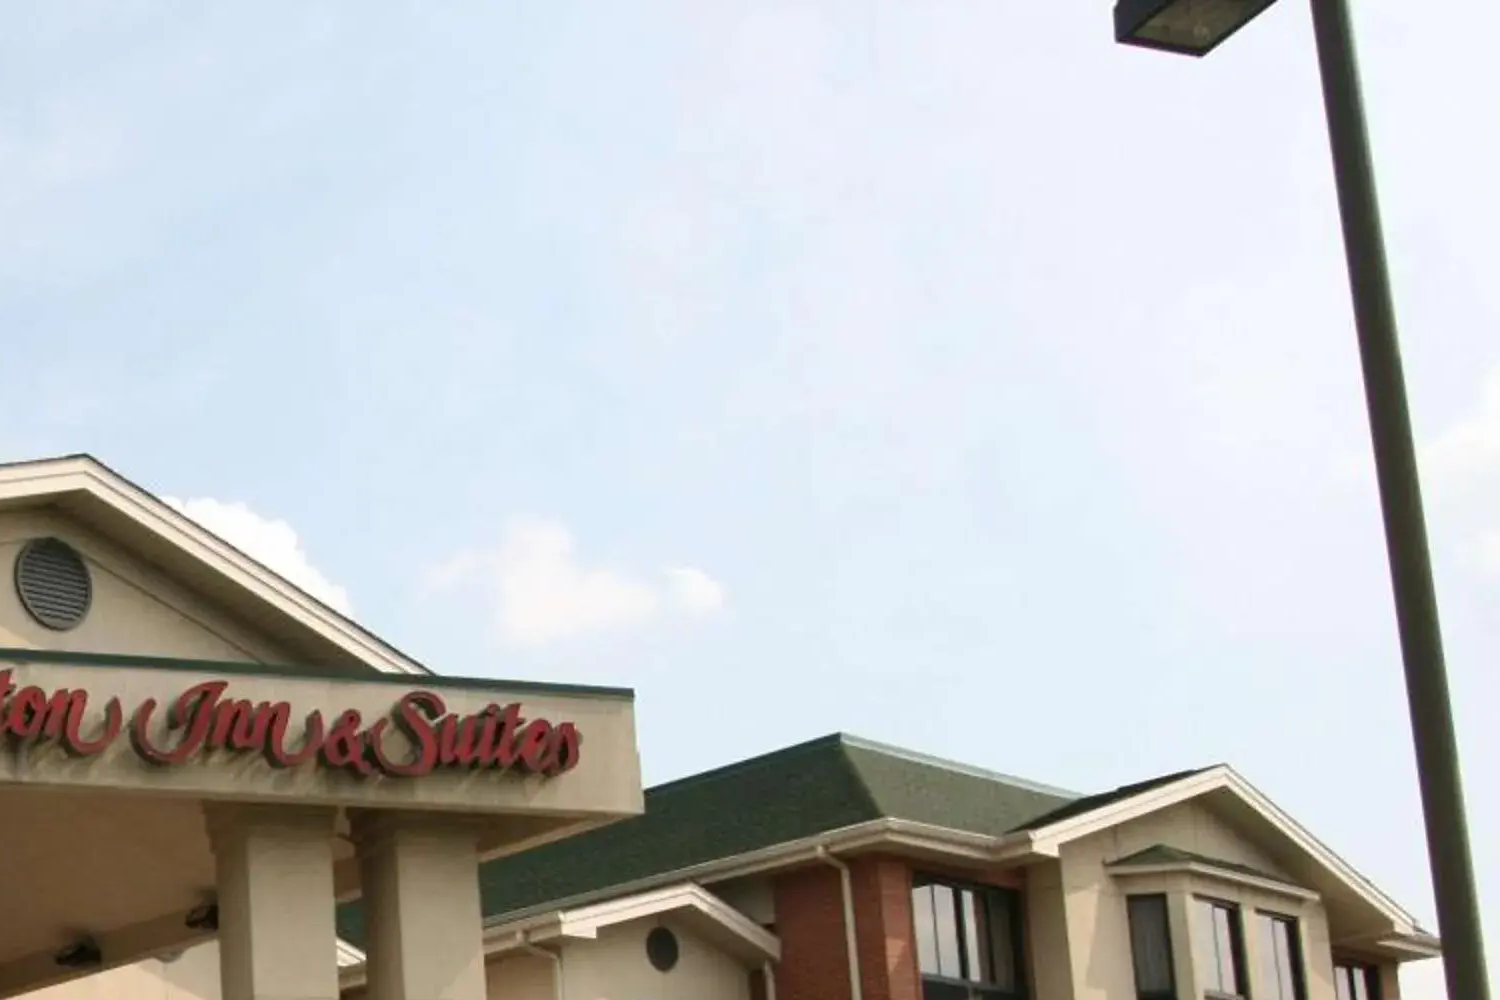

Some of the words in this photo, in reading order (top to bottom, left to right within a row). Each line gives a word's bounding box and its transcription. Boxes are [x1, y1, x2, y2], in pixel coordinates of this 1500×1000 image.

[129, 681, 323, 769] Inn
[322, 708, 372, 776] &
[367, 689, 580, 778] Suites
